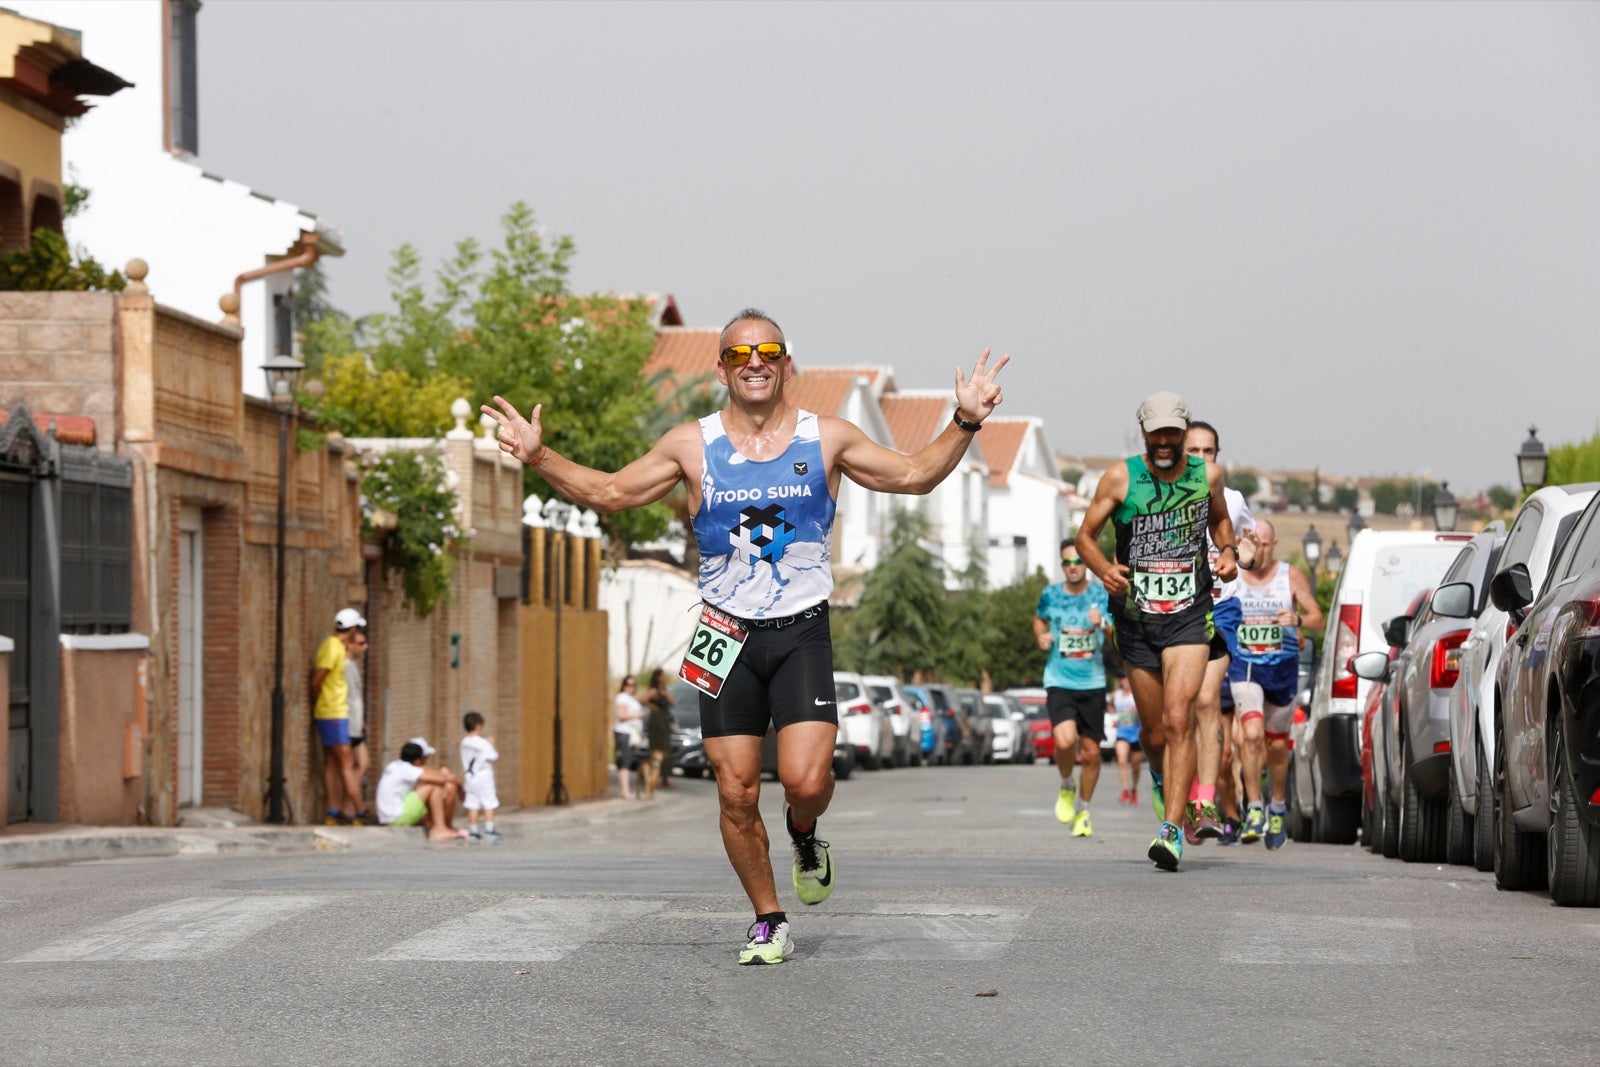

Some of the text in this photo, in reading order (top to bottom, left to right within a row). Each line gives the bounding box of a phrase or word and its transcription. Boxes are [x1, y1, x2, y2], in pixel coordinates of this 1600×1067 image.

[716, 484, 812, 504] TODO SUMA
[1131, 514, 1164, 537] TEAM
[1140, 575, 1193, 596] 1134
[1067, 637, 1091, 649] 251
[1240, 627, 1280, 641] 1078
[689, 628, 728, 667] 26
